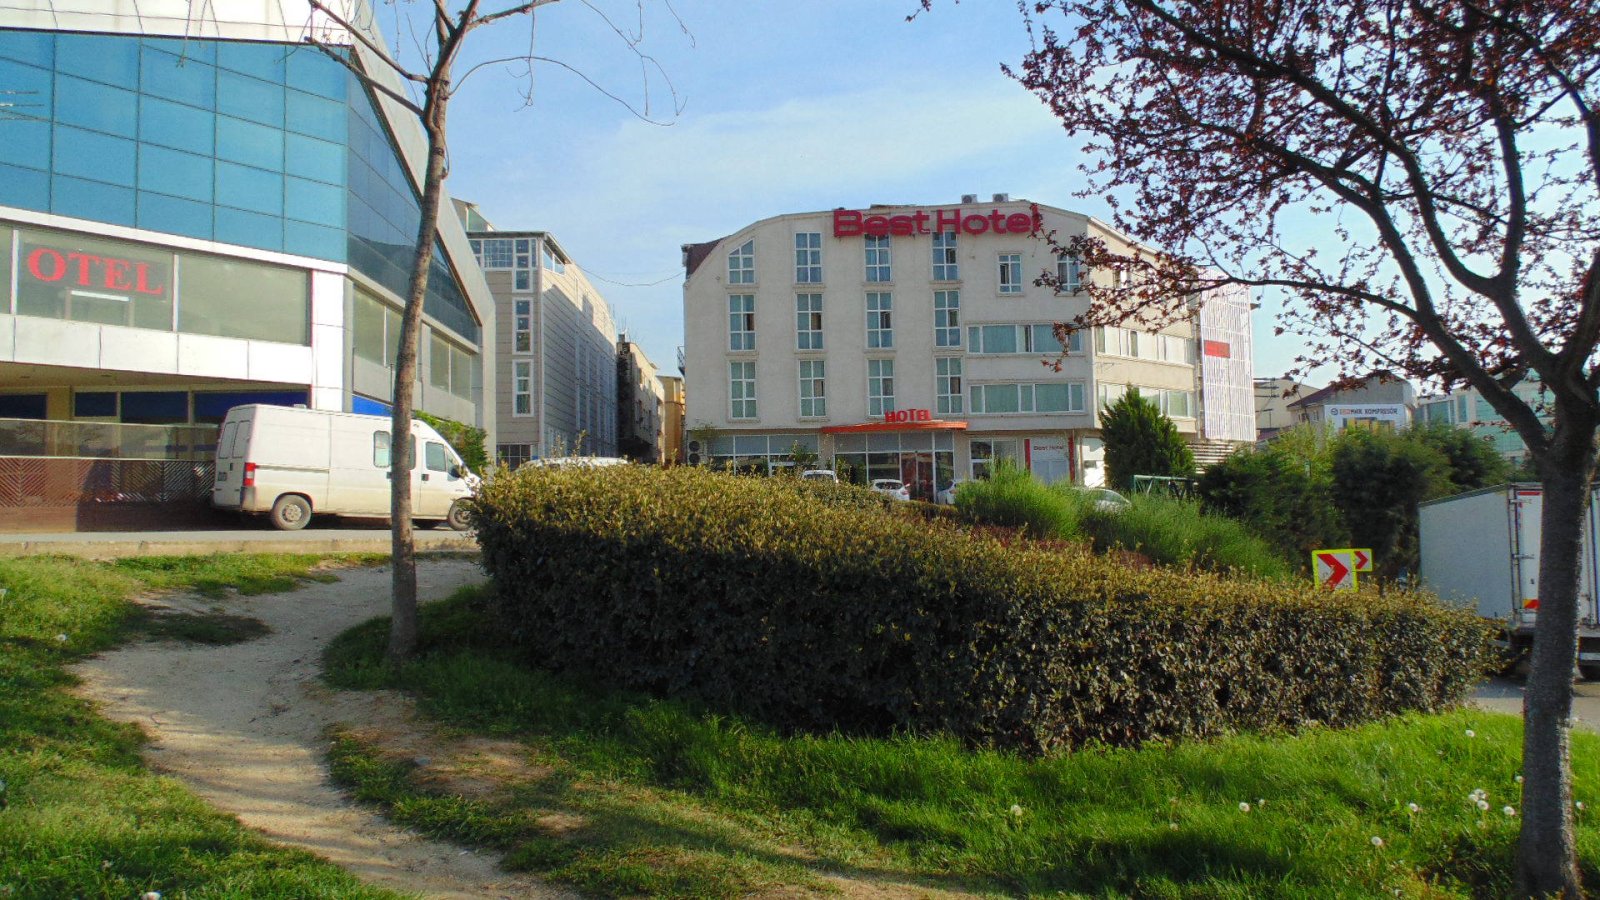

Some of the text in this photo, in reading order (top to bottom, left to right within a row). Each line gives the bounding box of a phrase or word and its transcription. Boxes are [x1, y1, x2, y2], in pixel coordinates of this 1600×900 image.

[833, 209, 930, 238] Best
[27, 247, 164, 295] OTEL
[884, 408, 931, 422] HOTEL
